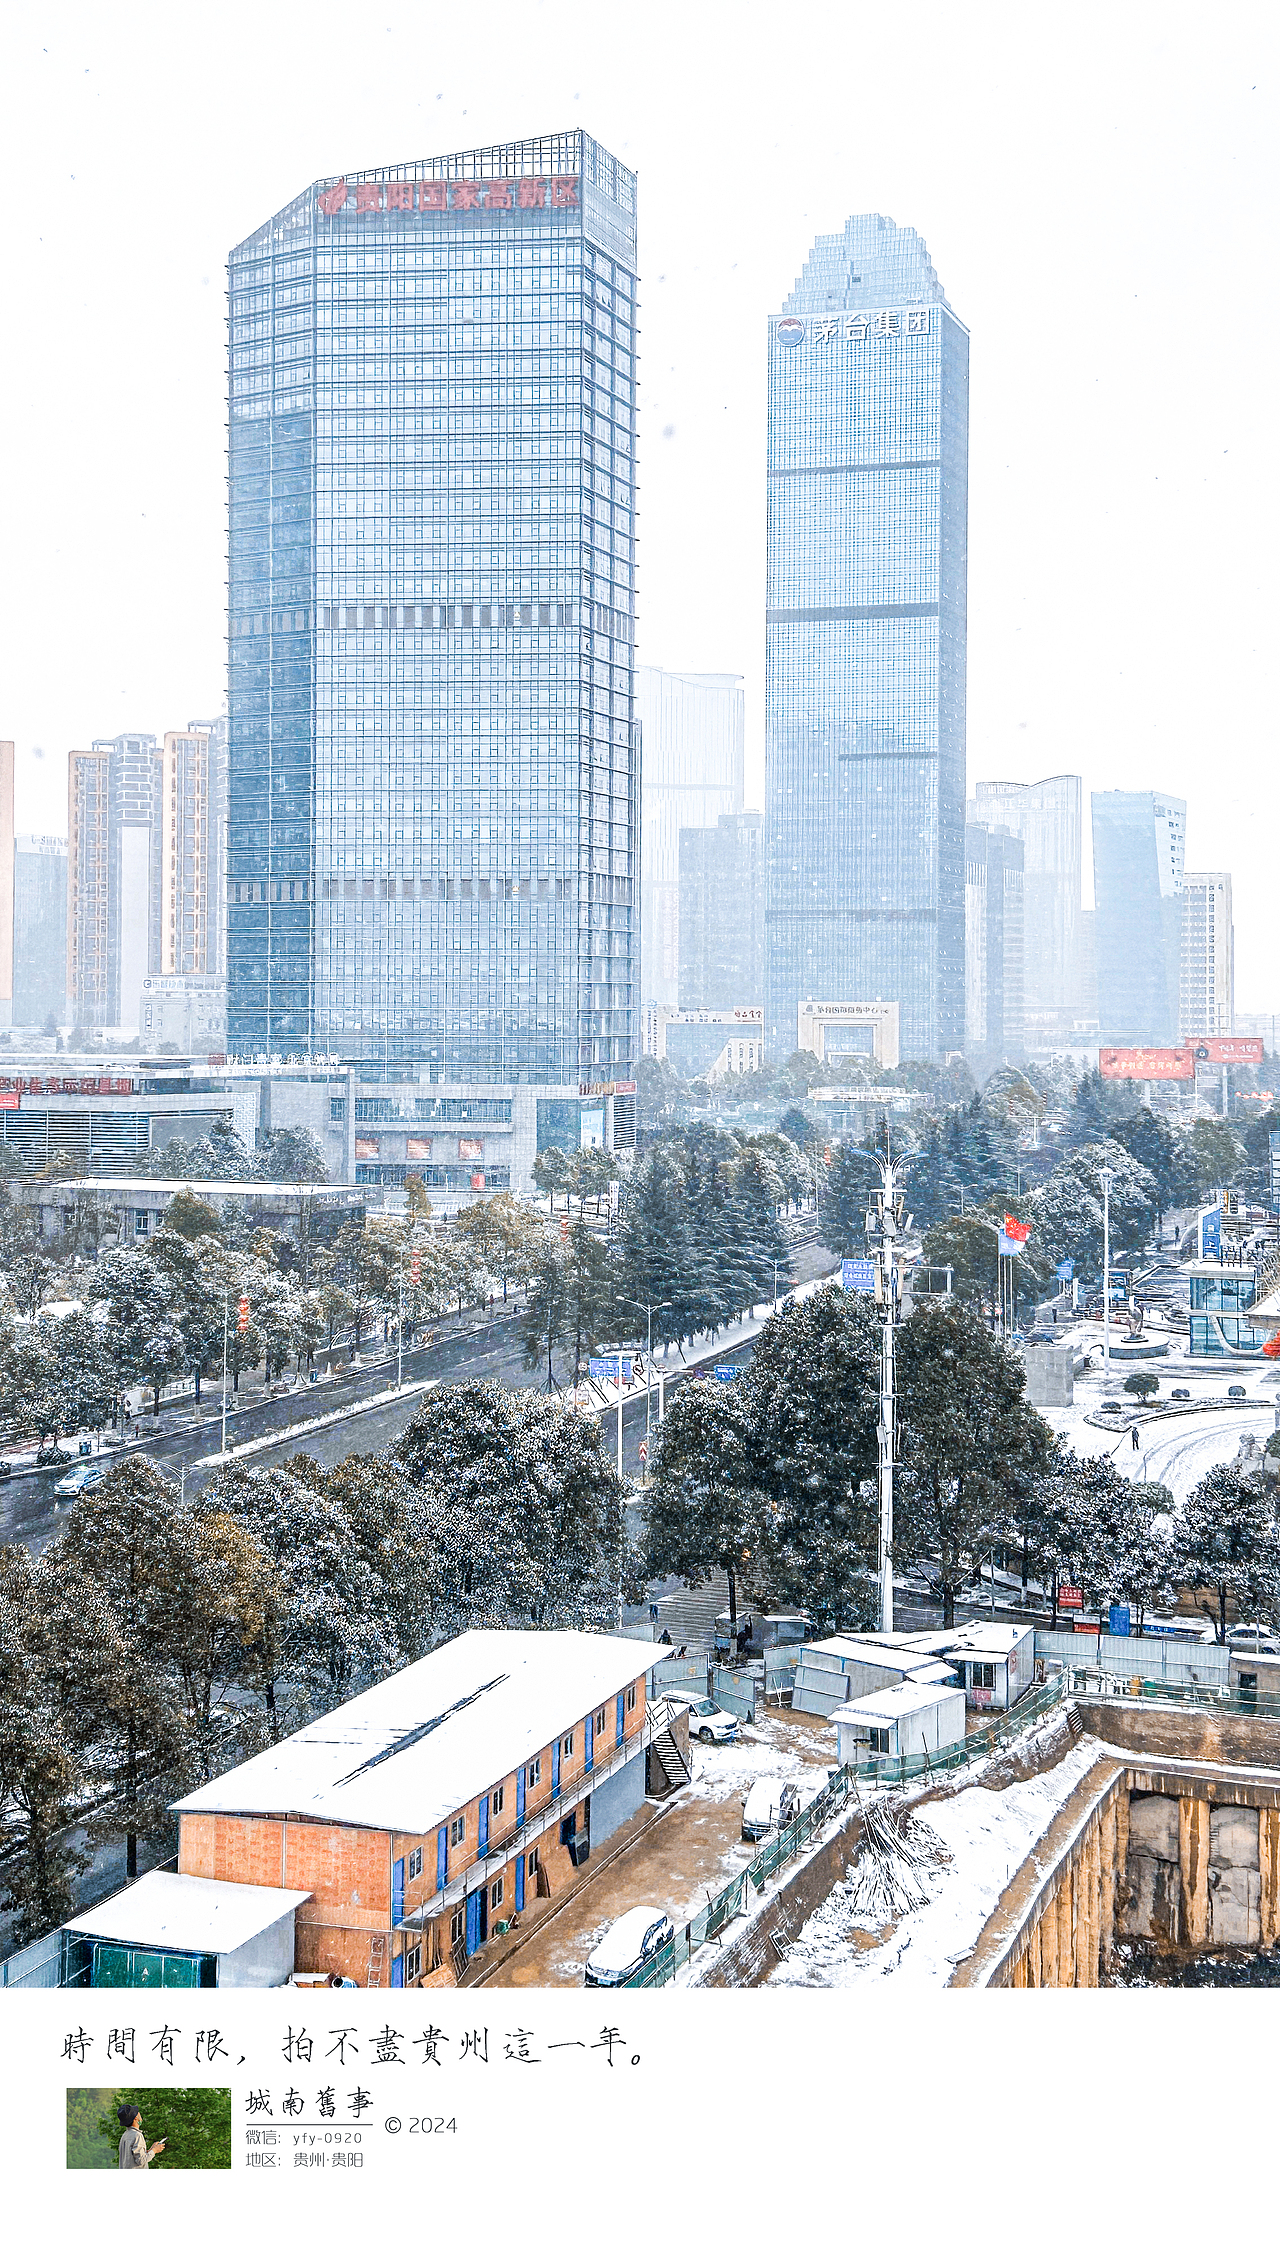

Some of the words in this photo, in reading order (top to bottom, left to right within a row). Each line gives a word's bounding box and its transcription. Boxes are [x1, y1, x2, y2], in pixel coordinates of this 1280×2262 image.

[357, 178, 579, 211] 贵阳国家高新区
[813, 310, 931, 344] 茅台集团
